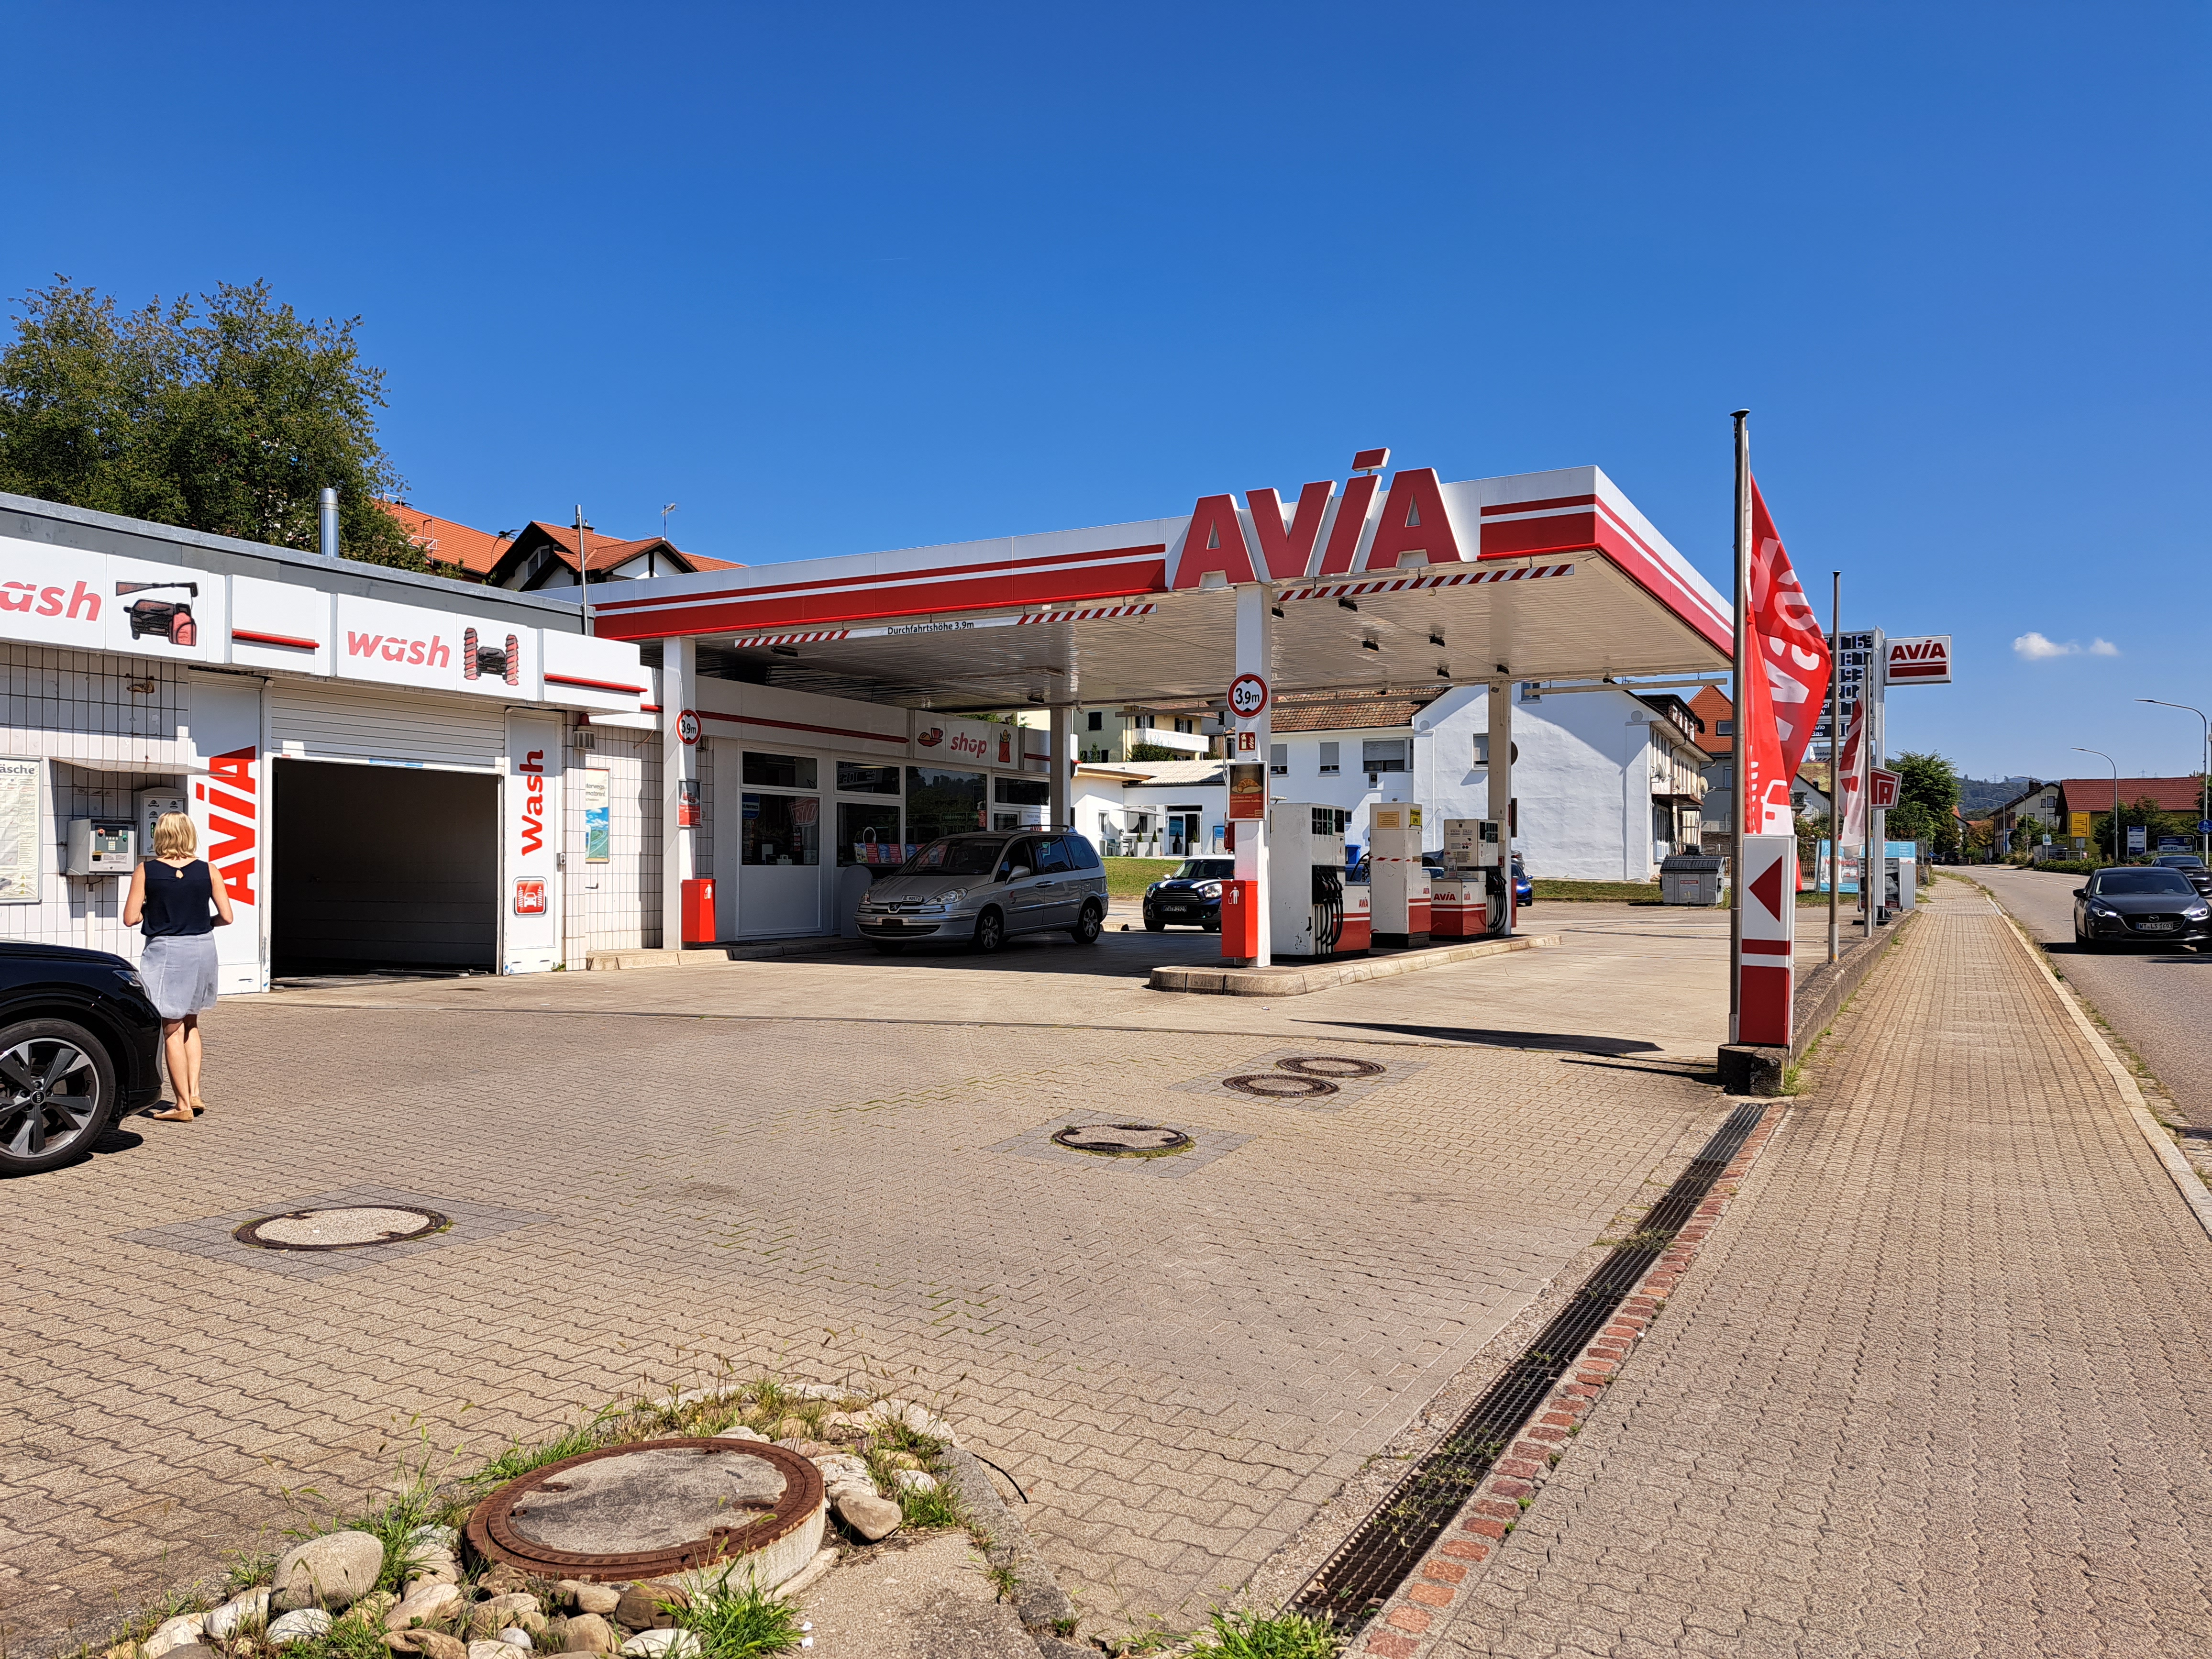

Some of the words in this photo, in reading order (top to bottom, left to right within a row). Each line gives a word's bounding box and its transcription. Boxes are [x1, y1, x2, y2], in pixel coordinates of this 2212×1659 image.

[1172, 448, 1464, 589] AVIA
[0, 581, 101, 621] ash
[888, 622, 952, 635] Durchfahrtshöhe
[955, 621, 974, 630] 3,9m
[347, 631, 450, 668] wash
[1890, 640, 1946, 661] AVIA
[1235, 687, 1260, 706] 3,9m
[681, 719, 697, 734] 3,9m
[950, 732, 987, 758] shop
[0, 764, 35, 774] äsche
[196, 745, 255, 906] AVIA
[1359, 896, 1369, 908] AVIA
[1433, 891, 1456, 901] AVIA
